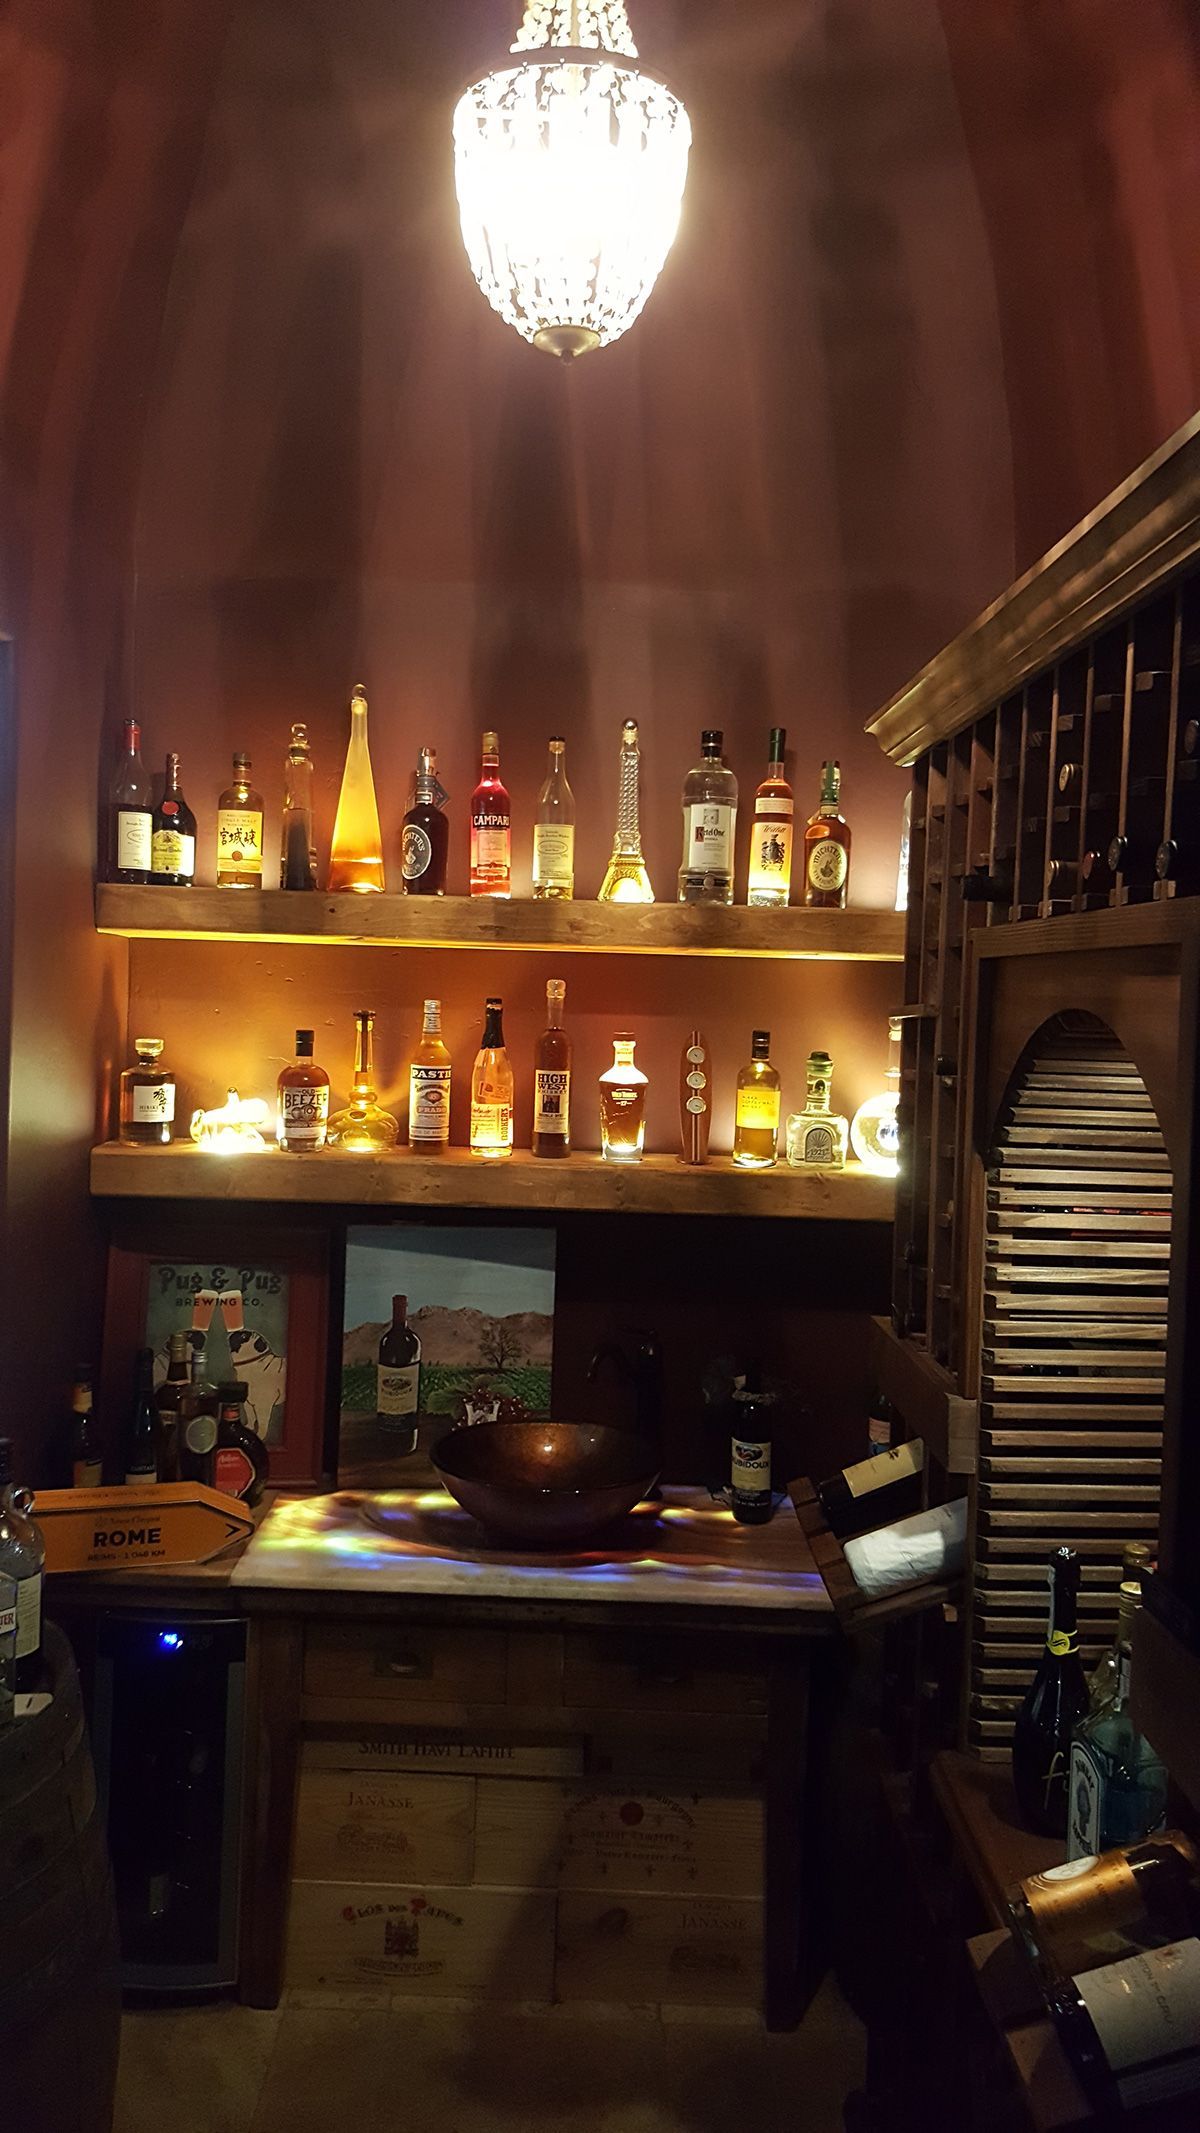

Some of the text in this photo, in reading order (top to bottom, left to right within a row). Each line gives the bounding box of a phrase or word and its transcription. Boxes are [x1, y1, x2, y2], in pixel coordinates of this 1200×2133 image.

[537, 1073, 568, 1083] HIGH
[158, 1267, 282, 1295] Pug & Pug
[176, 1298, 264, 1307] BREWING CO.
[94, 1528, 162, 1548] ROME
[151, 1549, 166, 1557] KM
